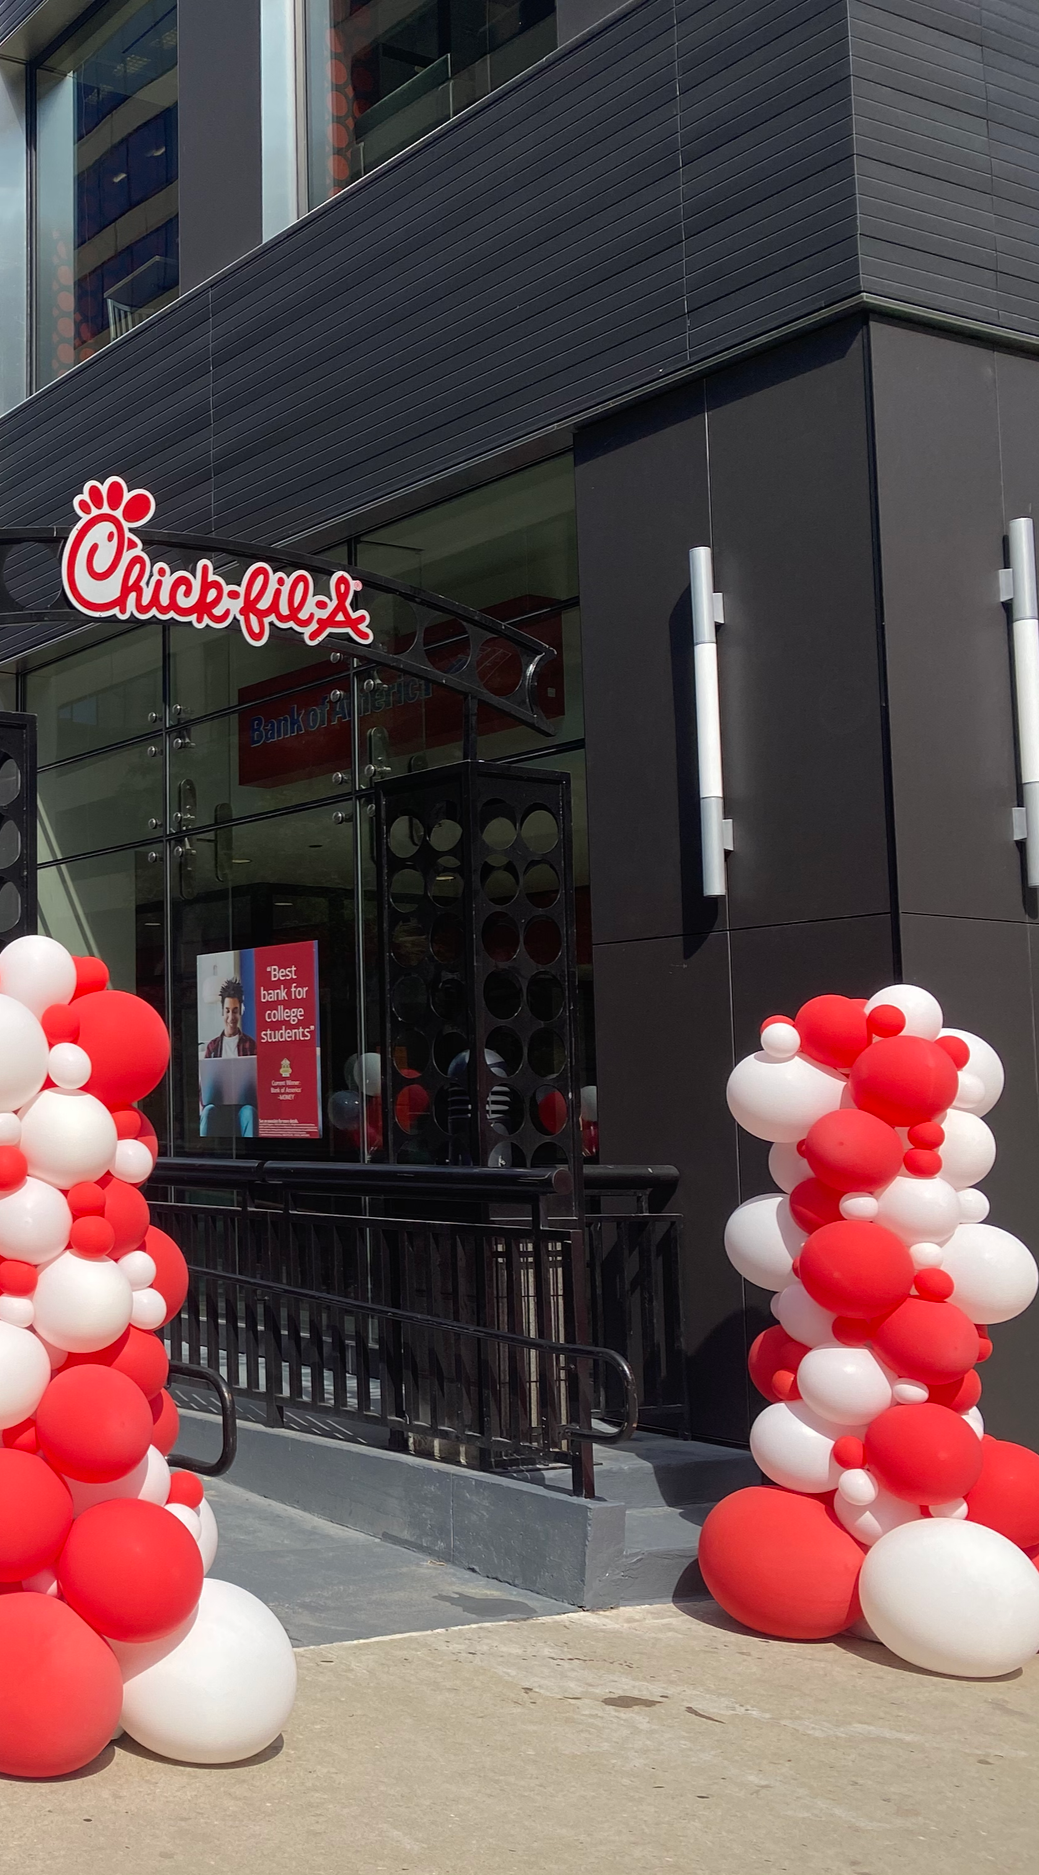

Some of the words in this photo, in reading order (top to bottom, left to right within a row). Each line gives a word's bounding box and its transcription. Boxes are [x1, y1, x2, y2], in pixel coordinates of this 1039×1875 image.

[250, 704, 305, 748] Bank
[306, 694, 332, 731] of
[260, 984, 288, 1002] bank
[291, 983, 309, 999] for
[265, 1005, 305, 1024] college
